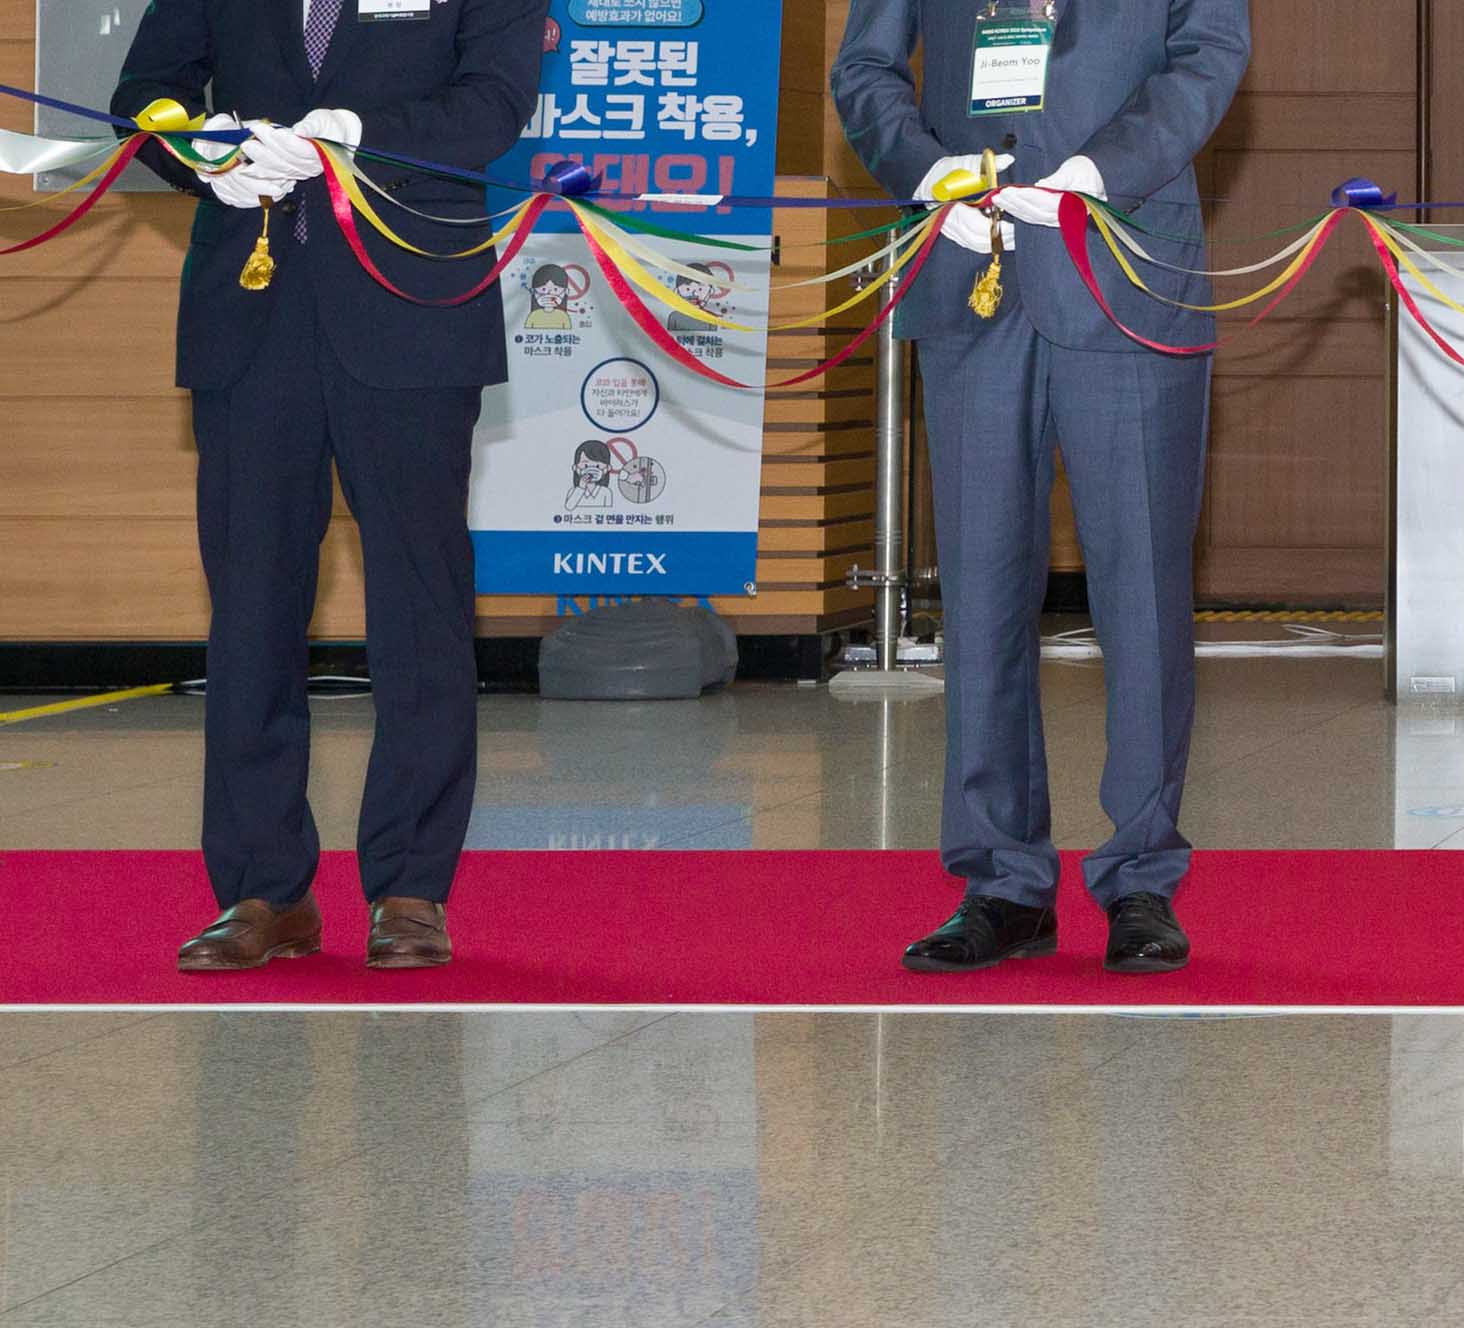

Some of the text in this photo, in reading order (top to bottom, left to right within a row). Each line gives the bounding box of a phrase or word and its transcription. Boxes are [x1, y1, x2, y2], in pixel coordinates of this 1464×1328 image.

[569, 40, 699, 87] 잘못된
[1022, 56, 1041, 66] Yoo
[985, 98, 1027, 108] ORGANIZER
[520, 92, 758, 147] 마스크 착용,
[563, 514, 592, 524] 마스크
[553, 553, 667, 575] KINTEX
